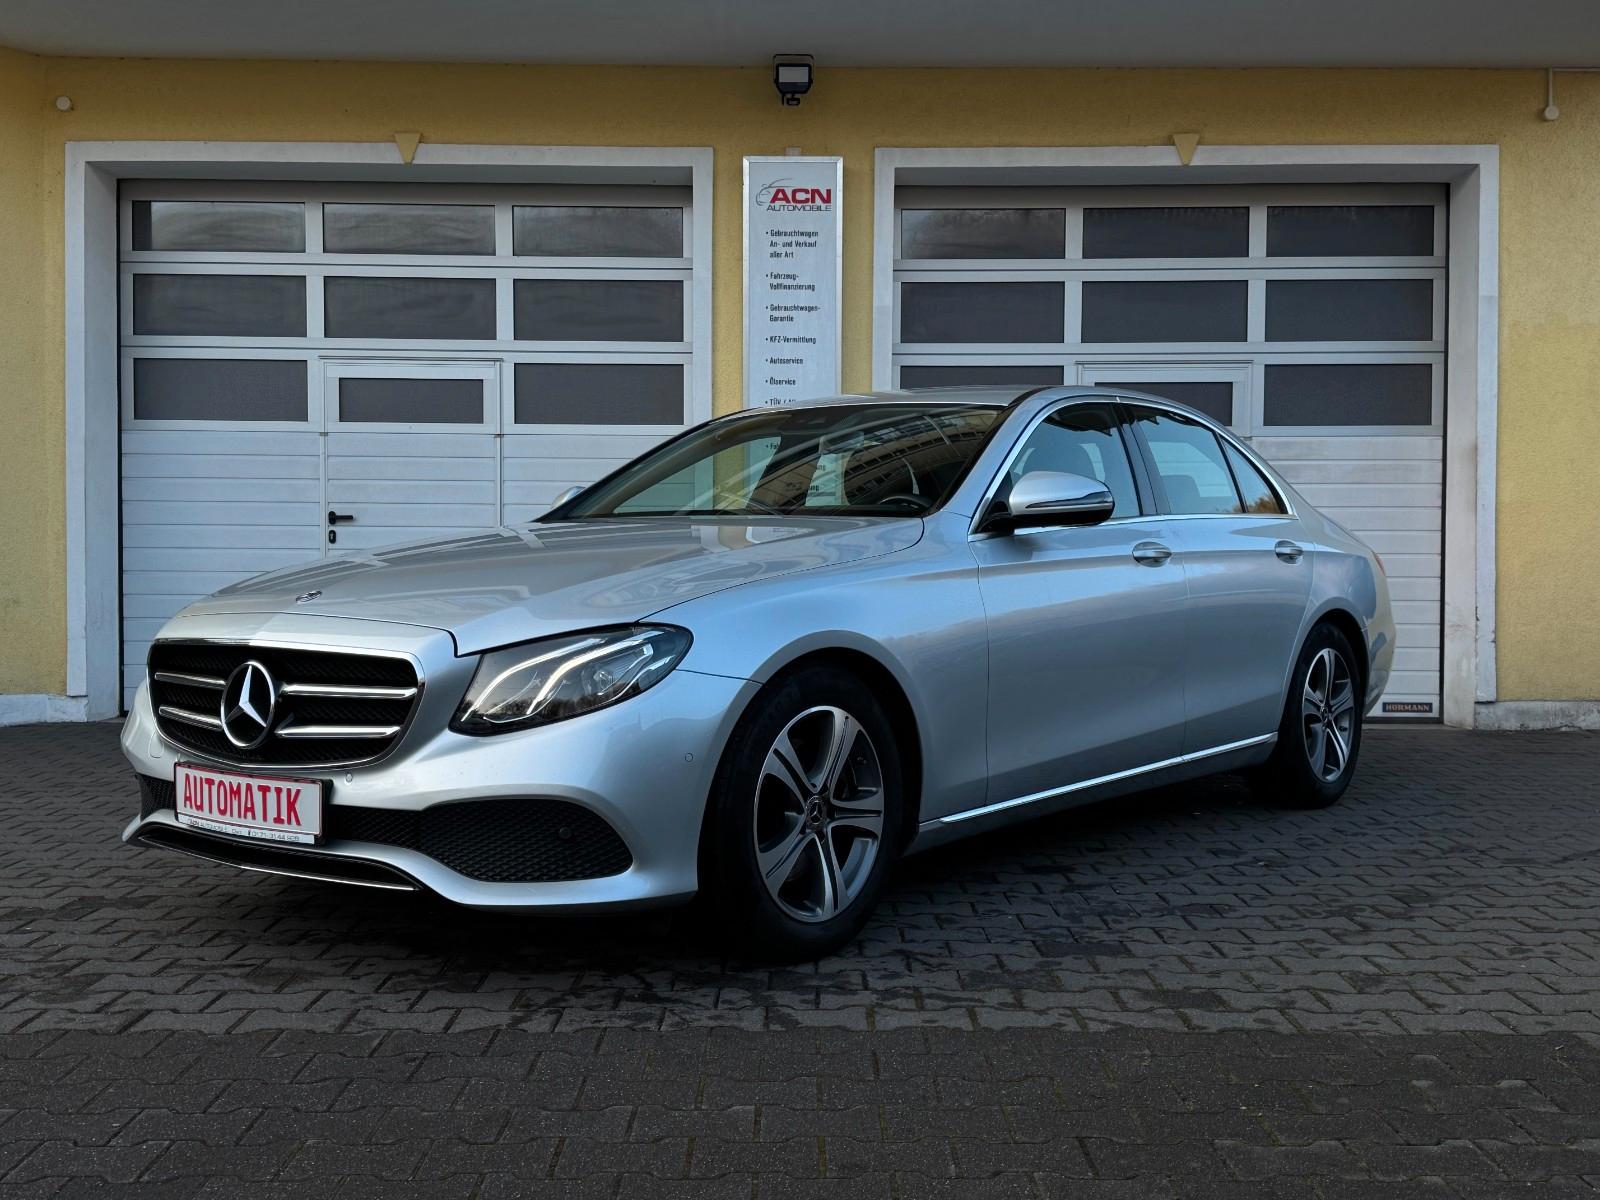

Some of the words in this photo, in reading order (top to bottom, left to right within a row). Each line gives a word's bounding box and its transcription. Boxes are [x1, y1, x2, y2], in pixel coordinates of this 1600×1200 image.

[769, 188, 832, 204] ACN
[766, 204, 832, 212] AUTOMOBILE
[770, 229, 819, 238] Gebrauchtwagen
[769, 240, 780, 248] An-
[781, 240, 793, 248] und
[794, 240, 817, 248] Verkauf
[784, 250, 794, 258] Art
[770, 272, 799, 281] Fahrzeug-
[769, 282, 816, 292] Vollfinanzierung
[769, 303, 821, 313] Gebrauchtwagen-
[769, 314, 794, 322] Garantie
[769, 336, 817, 344] KFZ-Vermittlung
[769, 357, 804, 365] Autoservice
[769, 376, 796, 385] Ölservice
[183, 772, 302, 827] AUTOMATIK
